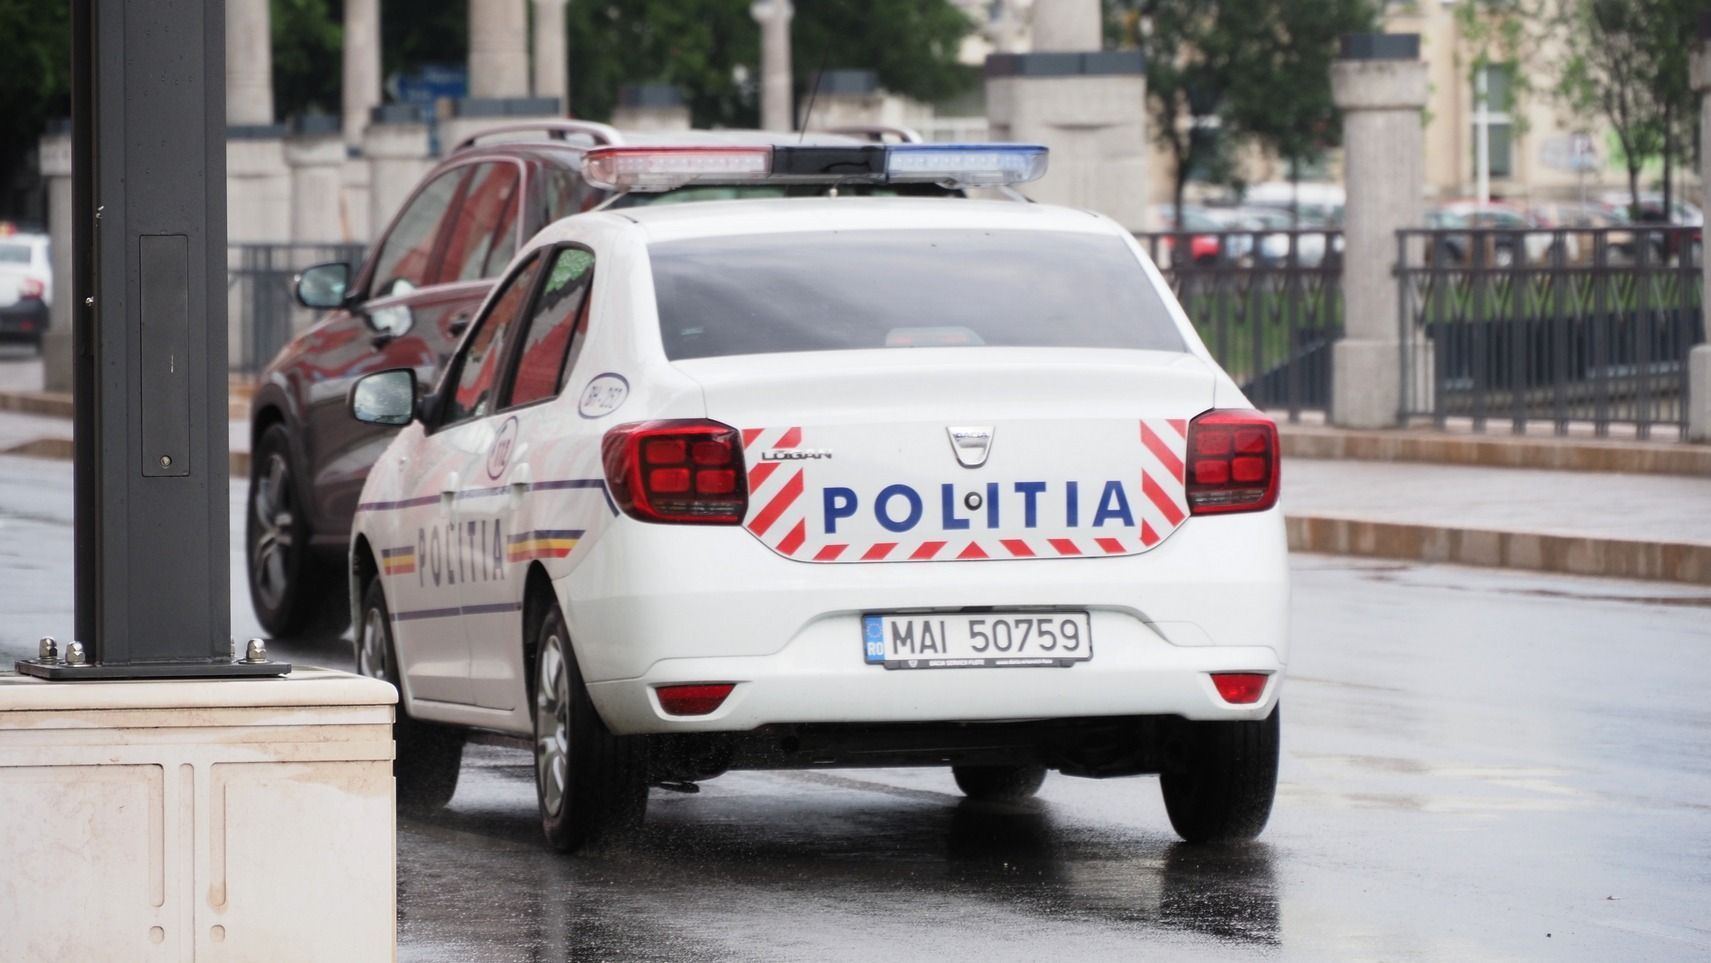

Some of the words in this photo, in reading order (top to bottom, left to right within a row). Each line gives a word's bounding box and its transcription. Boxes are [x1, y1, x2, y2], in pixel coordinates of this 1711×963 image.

[761, 449, 832, 461] LOGAN
[823, 480, 1136, 534] POLITIA
[418, 518, 505, 588] POLITIA
[867, 641, 884, 656] RO
[891, 620, 947, 655] MAI
[968, 618, 1080, 653] 50759
